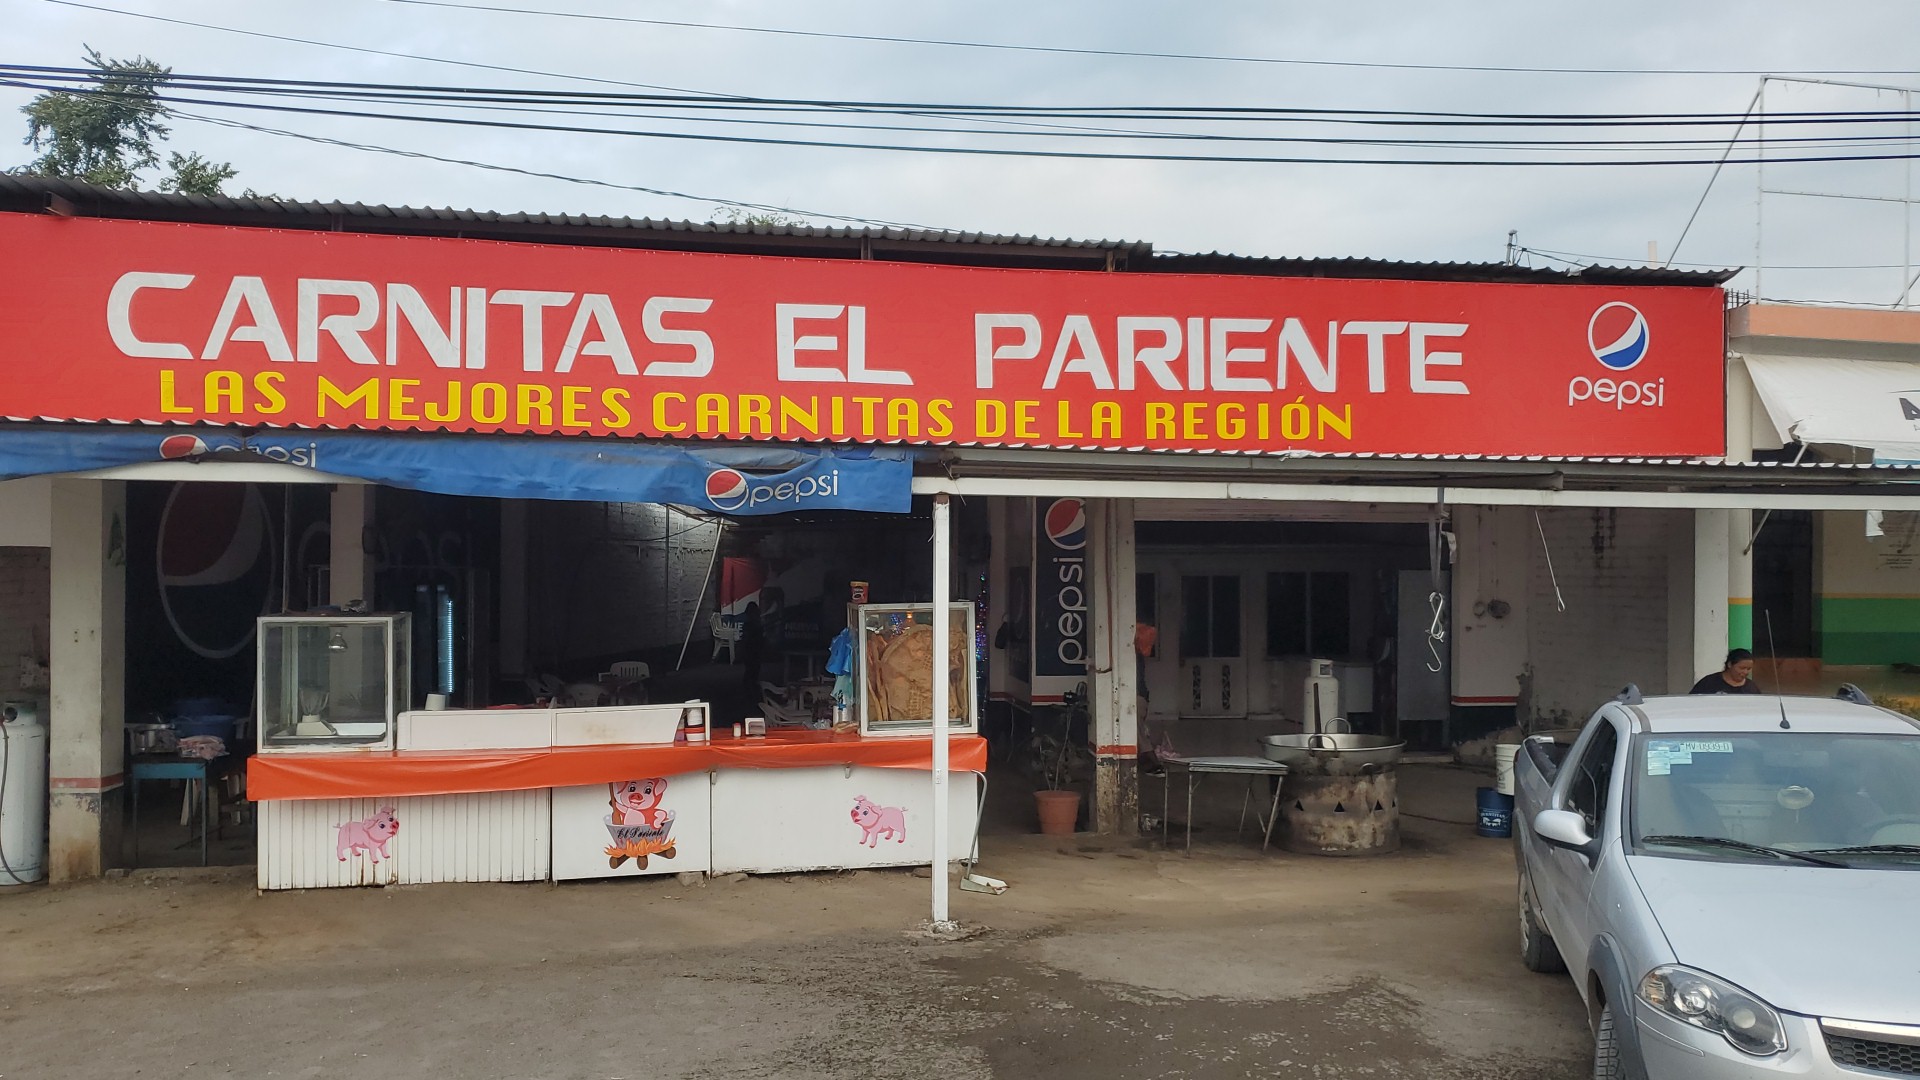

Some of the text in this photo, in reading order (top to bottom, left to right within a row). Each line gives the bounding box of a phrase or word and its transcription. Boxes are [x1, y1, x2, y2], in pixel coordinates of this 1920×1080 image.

[106, 271, 1470, 395] CARNITAS EL PARIENTE
[160, 370, 1352, 440] LAS MEJORES CARNITAS DE LA REGIÓN
[1568, 377, 1664, 410] pepsi
[749, 469, 839, 508] pepsi
[1053, 557, 1088, 665] pepsi
